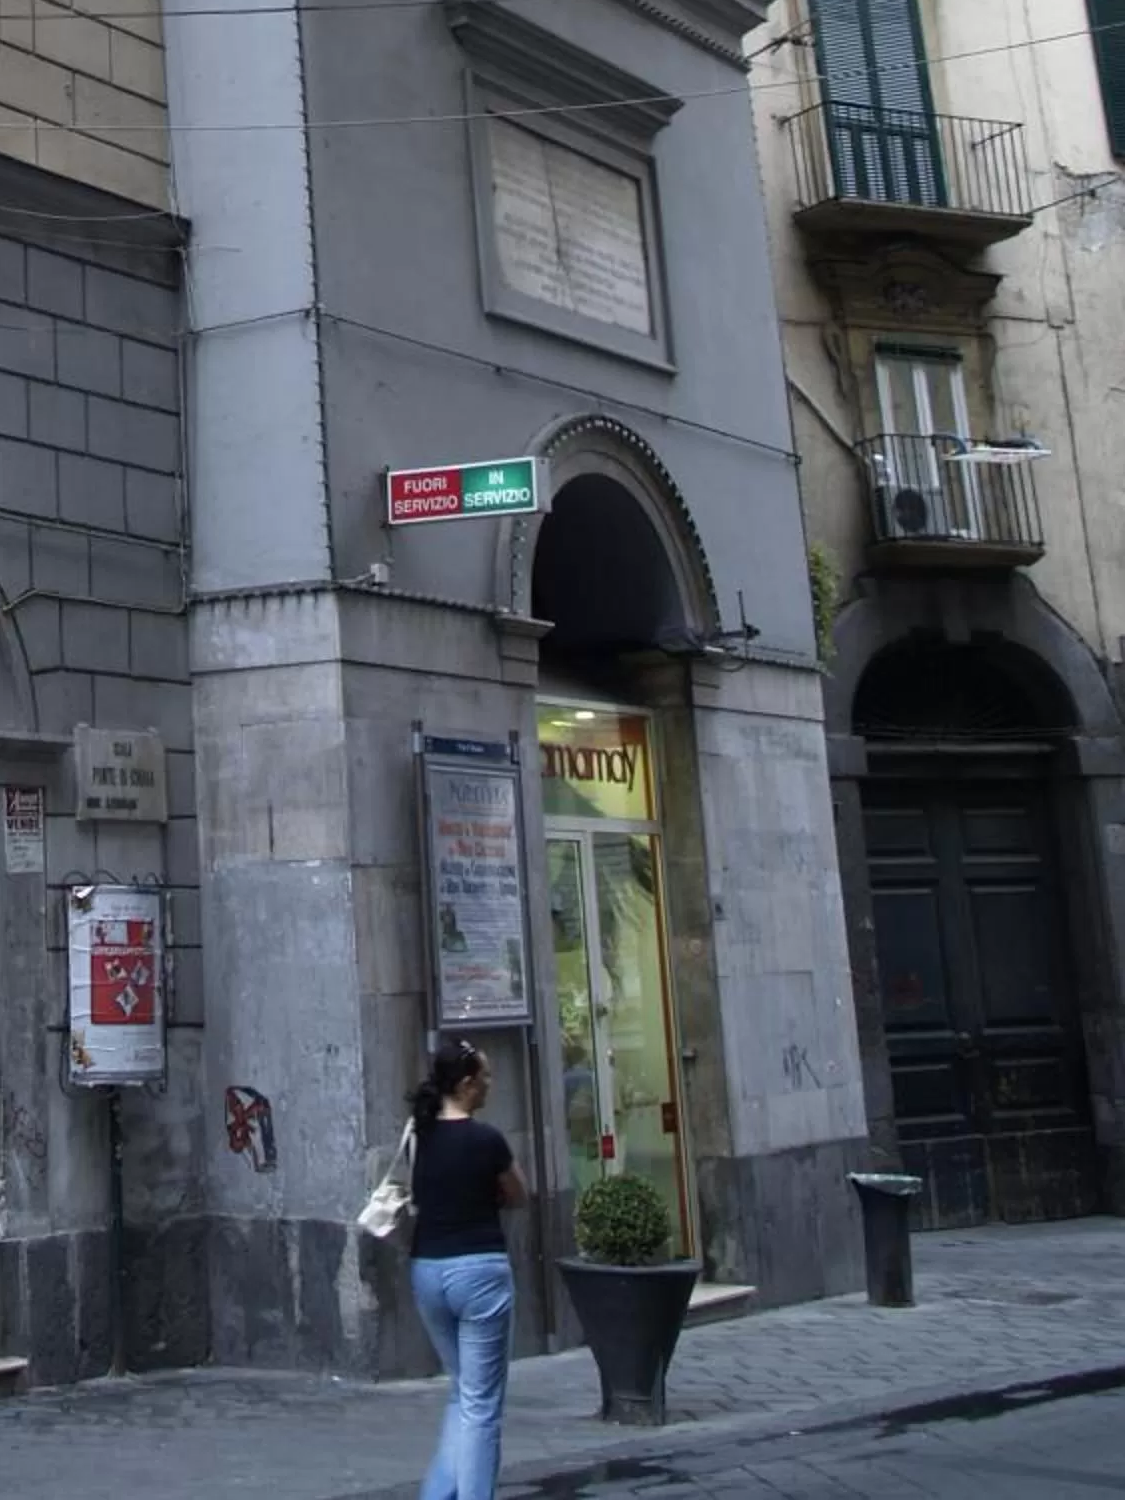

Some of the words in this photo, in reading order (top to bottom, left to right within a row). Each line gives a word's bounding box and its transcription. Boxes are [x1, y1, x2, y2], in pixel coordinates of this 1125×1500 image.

[404, 477, 447, 493] FUORI
[488, 470, 504, 485] IN
[394, 495, 459, 514] SERVIZIO
[463, 488, 531, 508] SERVIZIO
